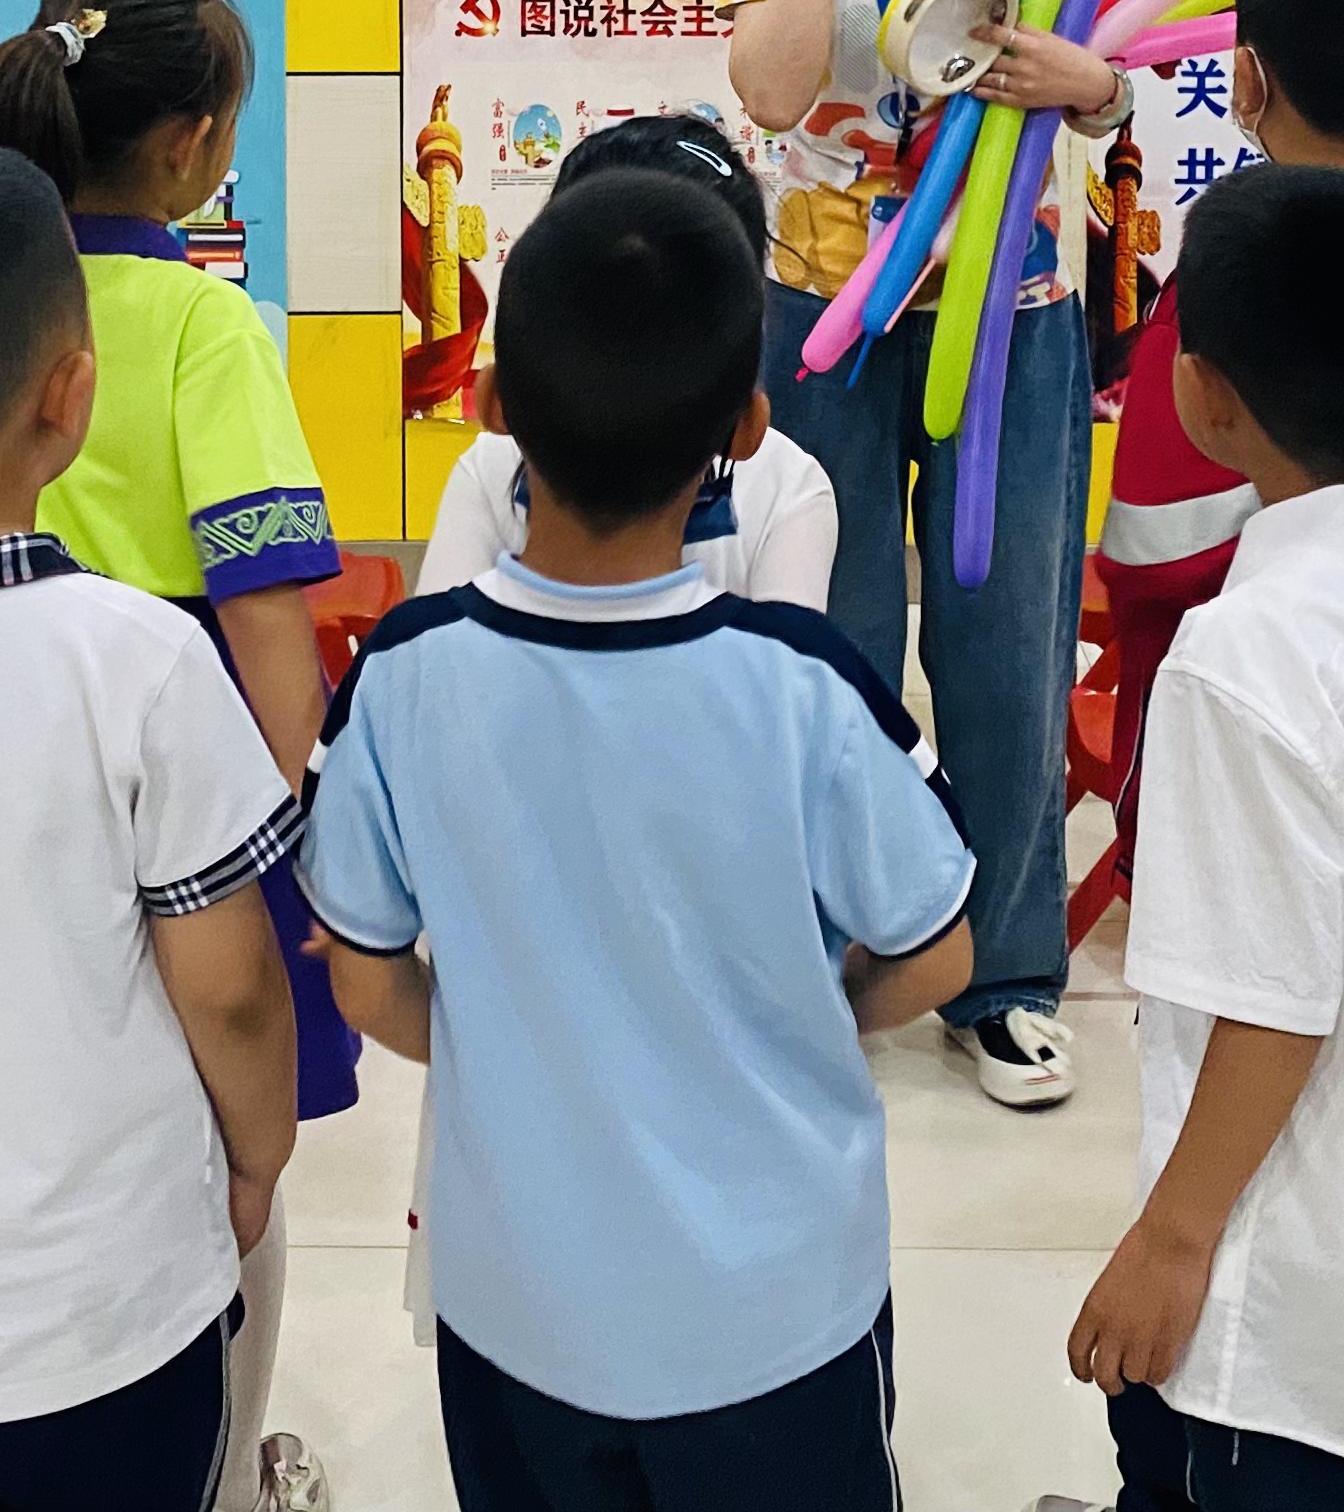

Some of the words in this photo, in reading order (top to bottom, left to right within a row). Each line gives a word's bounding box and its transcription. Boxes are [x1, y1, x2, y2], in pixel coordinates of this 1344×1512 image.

[492, 97, 505, 139] 富强
[576, 99, 590, 139] 民主
[495, 227, 510, 264] 公正
